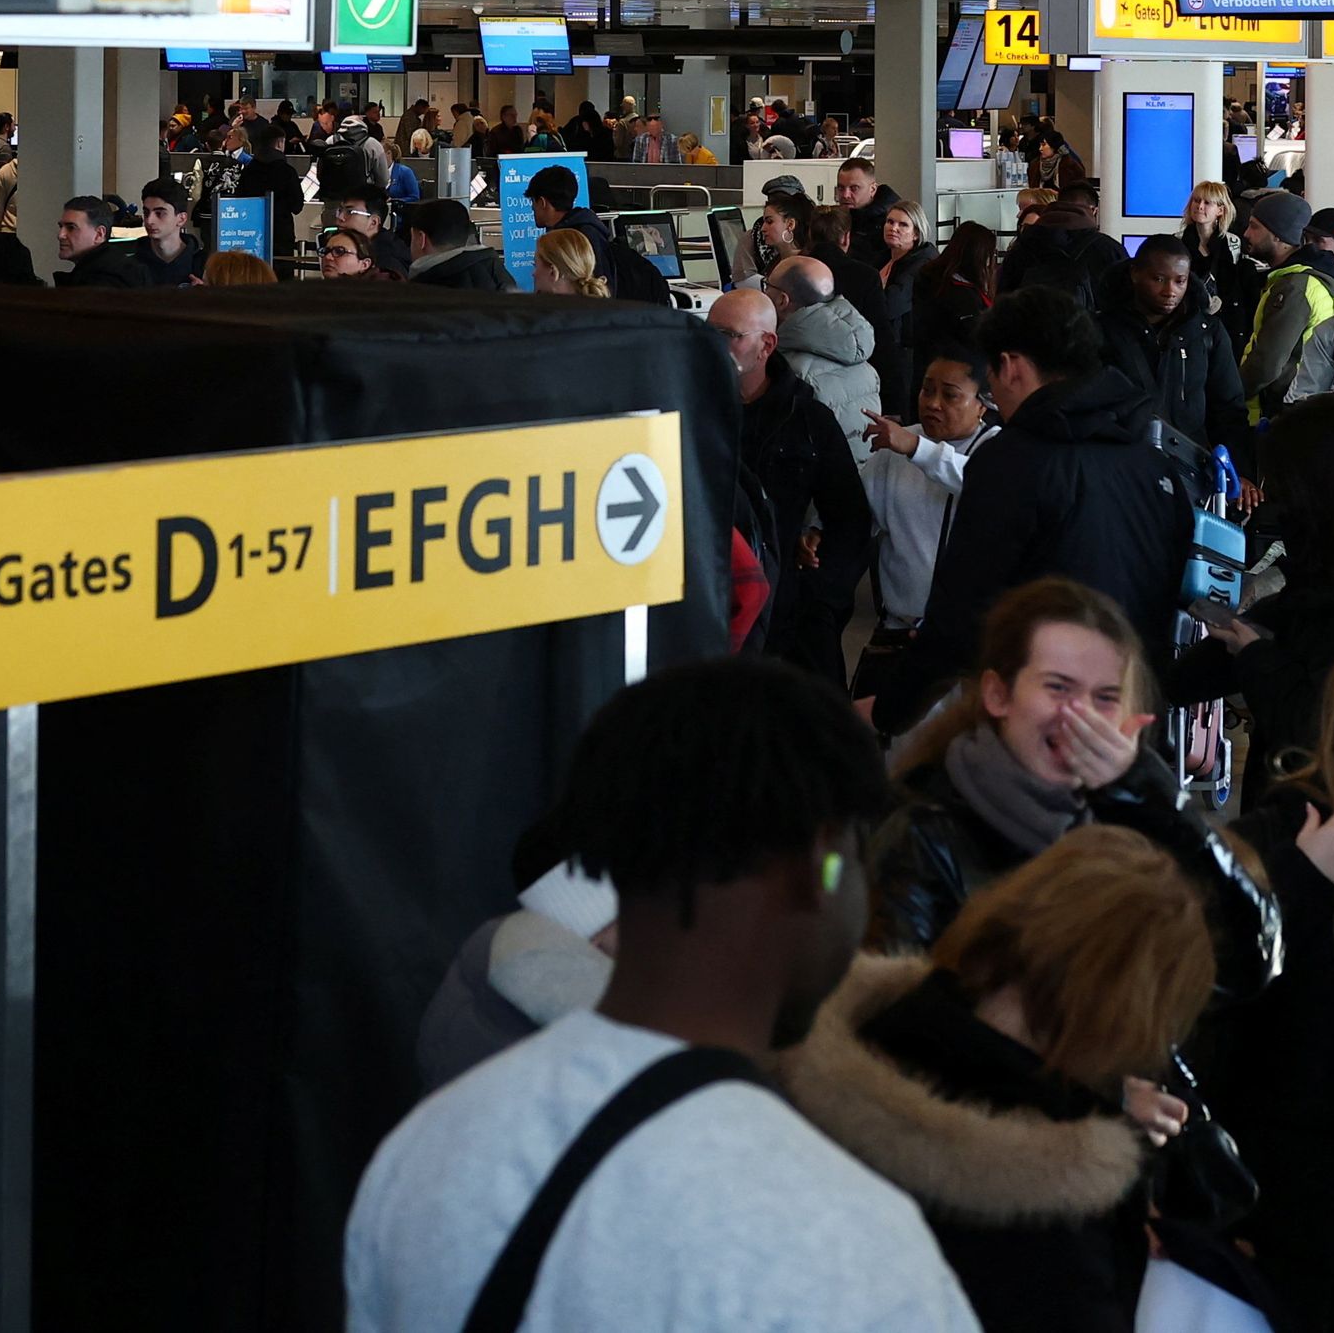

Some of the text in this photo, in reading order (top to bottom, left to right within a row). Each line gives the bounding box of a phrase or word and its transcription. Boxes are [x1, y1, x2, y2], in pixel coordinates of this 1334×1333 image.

[1135, 4, 1160, 21] Gates
[997, 15, 1038, 47] 14
[505, 175, 520, 183] KLM
[507, 197, 517, 206] Do
[510, 229, 525, 241] your
[354, 471, 575, 590] EFGH
